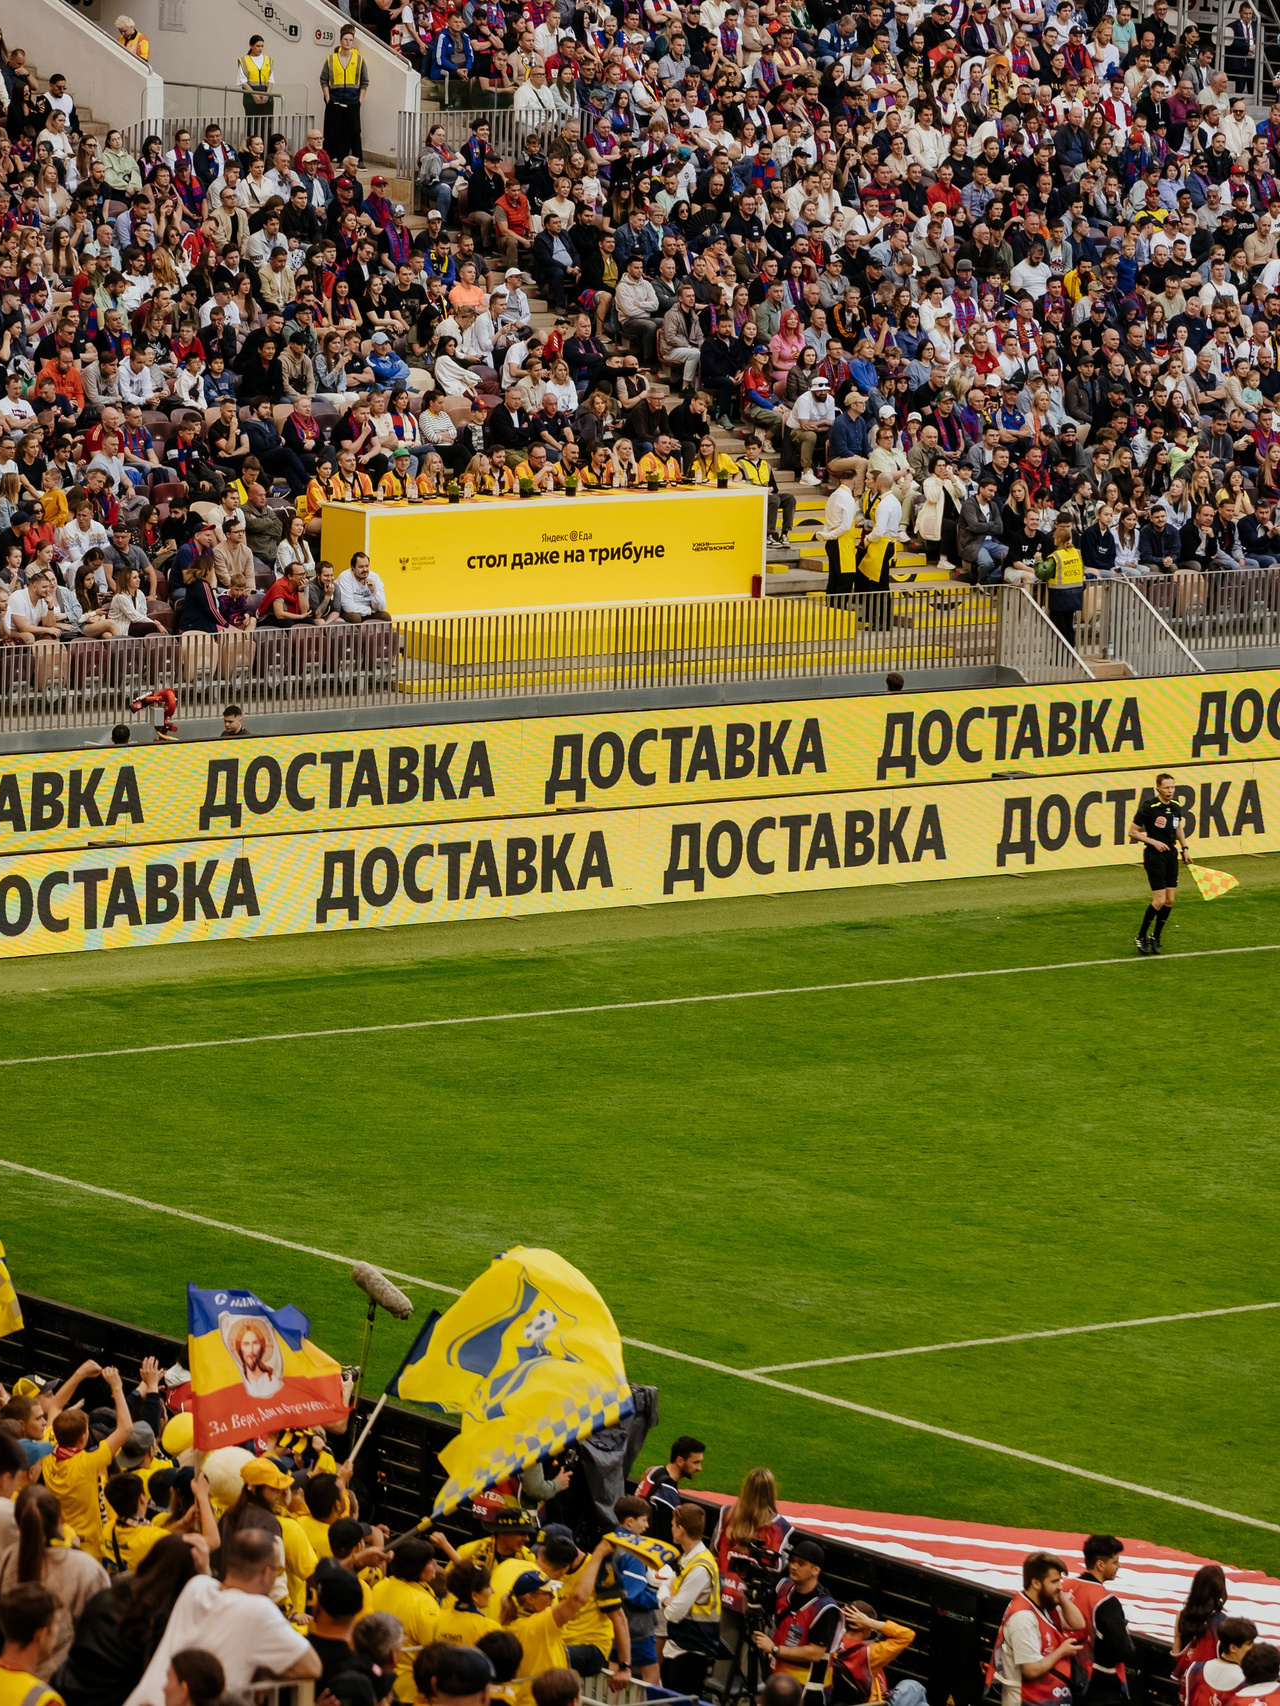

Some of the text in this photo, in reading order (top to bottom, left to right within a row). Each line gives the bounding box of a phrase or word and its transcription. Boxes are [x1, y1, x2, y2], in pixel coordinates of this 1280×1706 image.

[322, 32, 333, 40] 139
[541, 531, 593, 543] Яндекс Еда
[467, 541, 665, 571] стол даже на трибуне
[199, 741, 494, 830] ДОСТАВКА
[545, 718, 826, 804] ДОСТАВКА
[877, 698, 1144, 780] ДОСТАВКА
[316, 831, 613, 923] ДОСТАВКА
[663, 805, 946, 894] ДОСТАВКА
[209, 1420, 229, 1437] За
